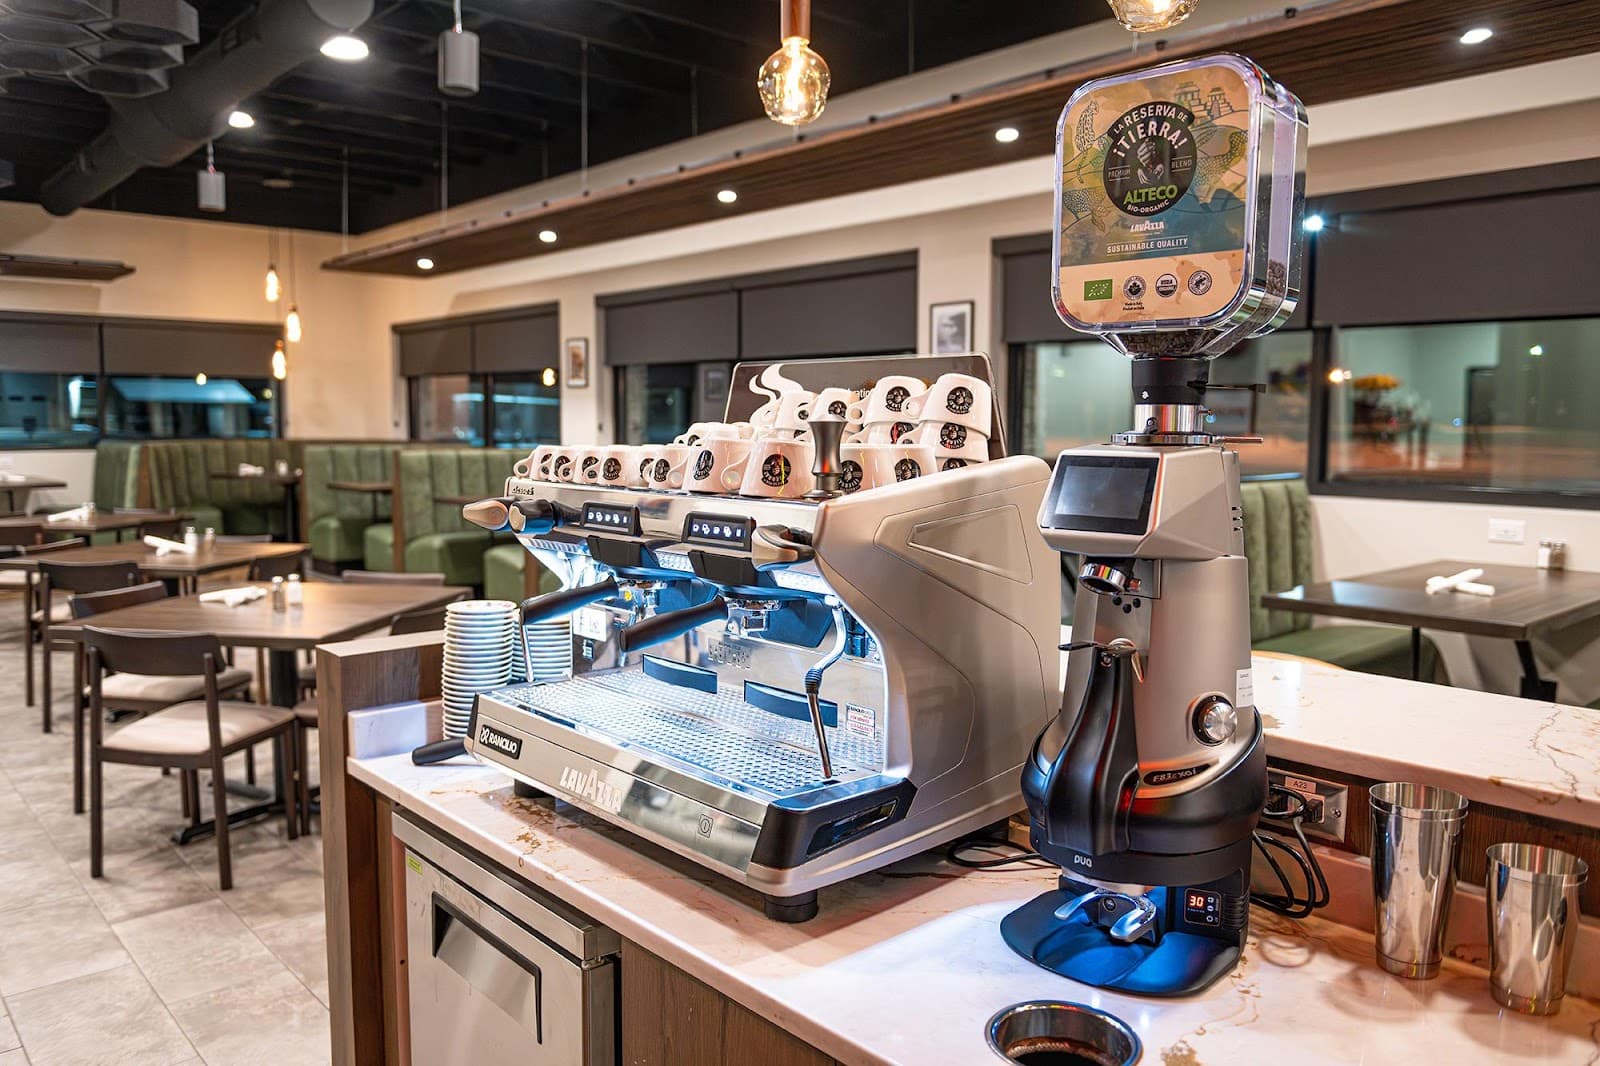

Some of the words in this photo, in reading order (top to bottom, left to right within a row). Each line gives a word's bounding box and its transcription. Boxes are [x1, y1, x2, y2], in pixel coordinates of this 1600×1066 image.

[1113, 123, 1124, 134] LA
[1124, 105, 1176, 126] RESERVA
[1177, 111, 1188, 122] DE
[1113, 120, 1188, 158] ¡TIERRA!
[1123, 184, 1178, 205] ALTECO
[1127, 199, 1170, 213] BIO-ORGANIC
[1130, 220, 1165, 233] LAVAZZA
[1106, 242, 1154, 254] SUSTAINABLE
[1156, 238, 1188, 248] QUALITY
[488, 732, 517, 754] RANCILIO
[559, 766, 624, 812] LAVAZZA
[1293, 780, 1307, 790] A23
[1189, 895, 1205, 907] 30
